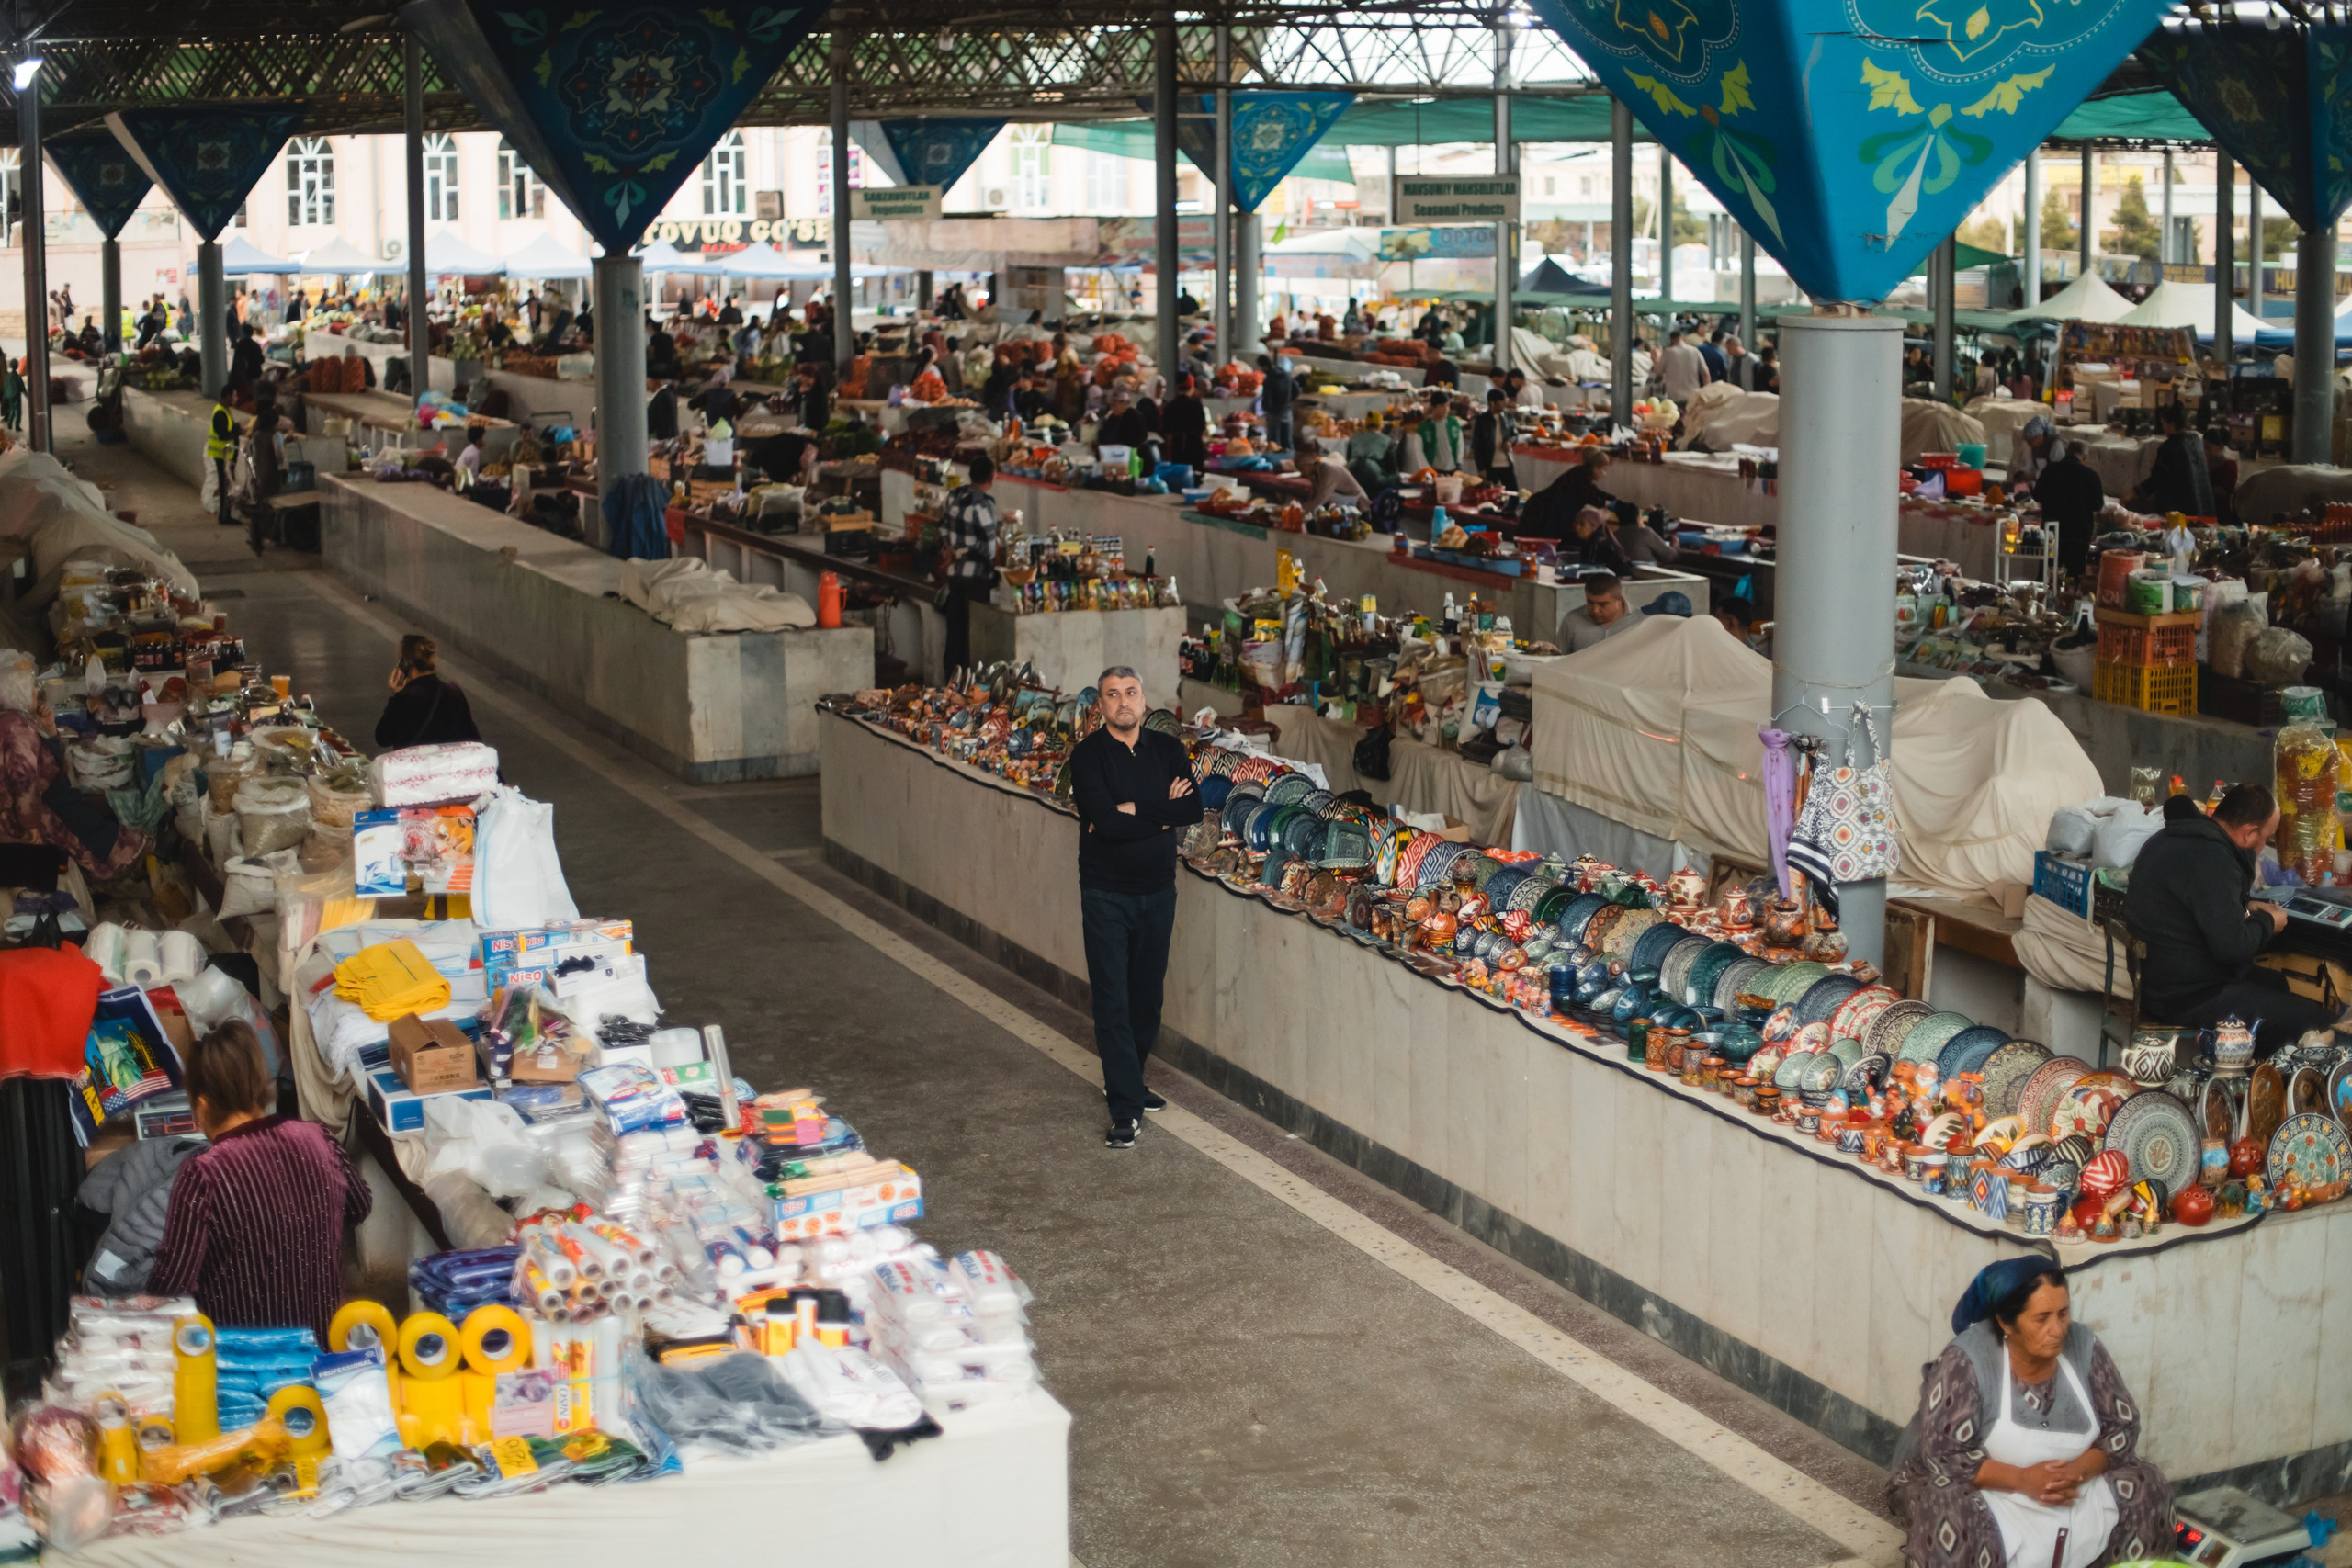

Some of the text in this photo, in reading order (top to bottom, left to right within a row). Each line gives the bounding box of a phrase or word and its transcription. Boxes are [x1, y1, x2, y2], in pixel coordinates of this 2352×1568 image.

[1414, 203, 1505, 216] Seasonal Products
[1441, 230, 1496, 243] OPTO
[82, 1086, 105, 1126] NEW
[318, 1359, 373, 1378] PROFESSIONAL
